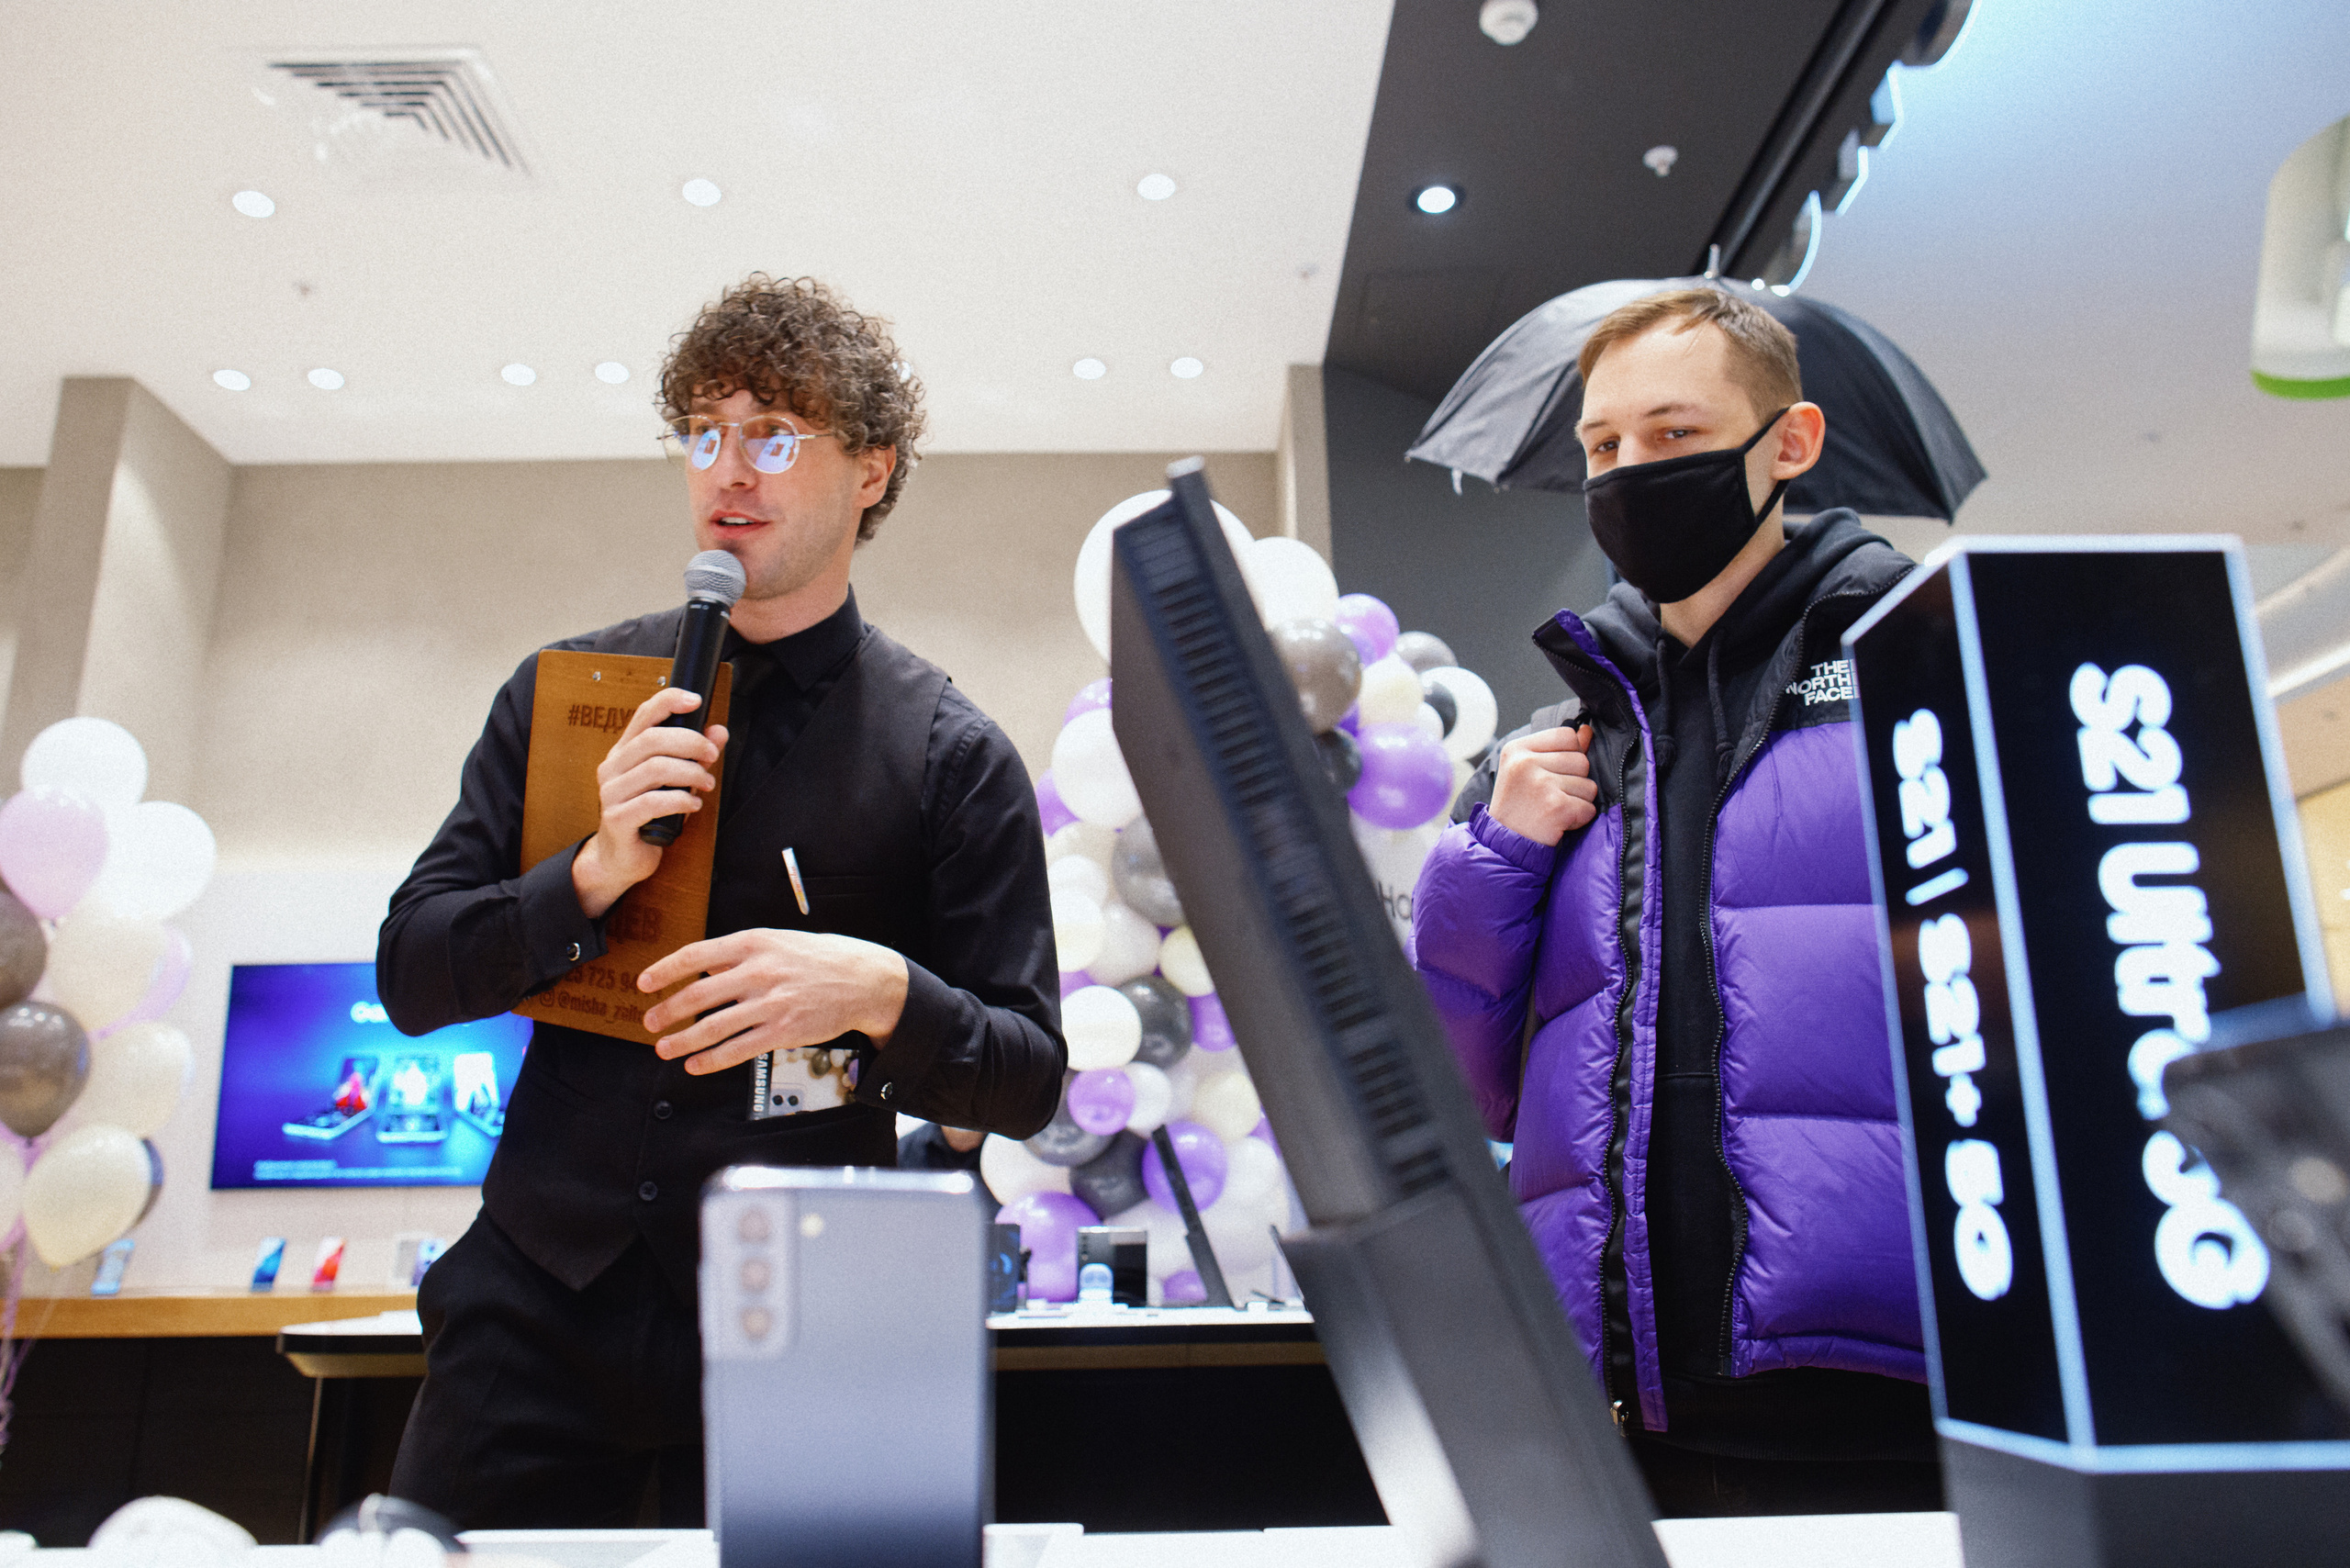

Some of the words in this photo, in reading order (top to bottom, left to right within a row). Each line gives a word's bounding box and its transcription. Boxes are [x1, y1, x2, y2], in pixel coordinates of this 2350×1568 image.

[1810, 660, 1851, 677] THE
[1785, 673, 1852, 695] NORTH
[1804, 686, 1854, 706] FACE
[567, 704, 637, 734] #ВЕДУ
[2069, 662, 2191, 824] S21
[1892, 709, 1956, 868] S21
[588, 965, 616, 991] 725
[1919, 913, 1986, 1126] S21+
[753, 1052, 768, 1113] SAMSUNG
